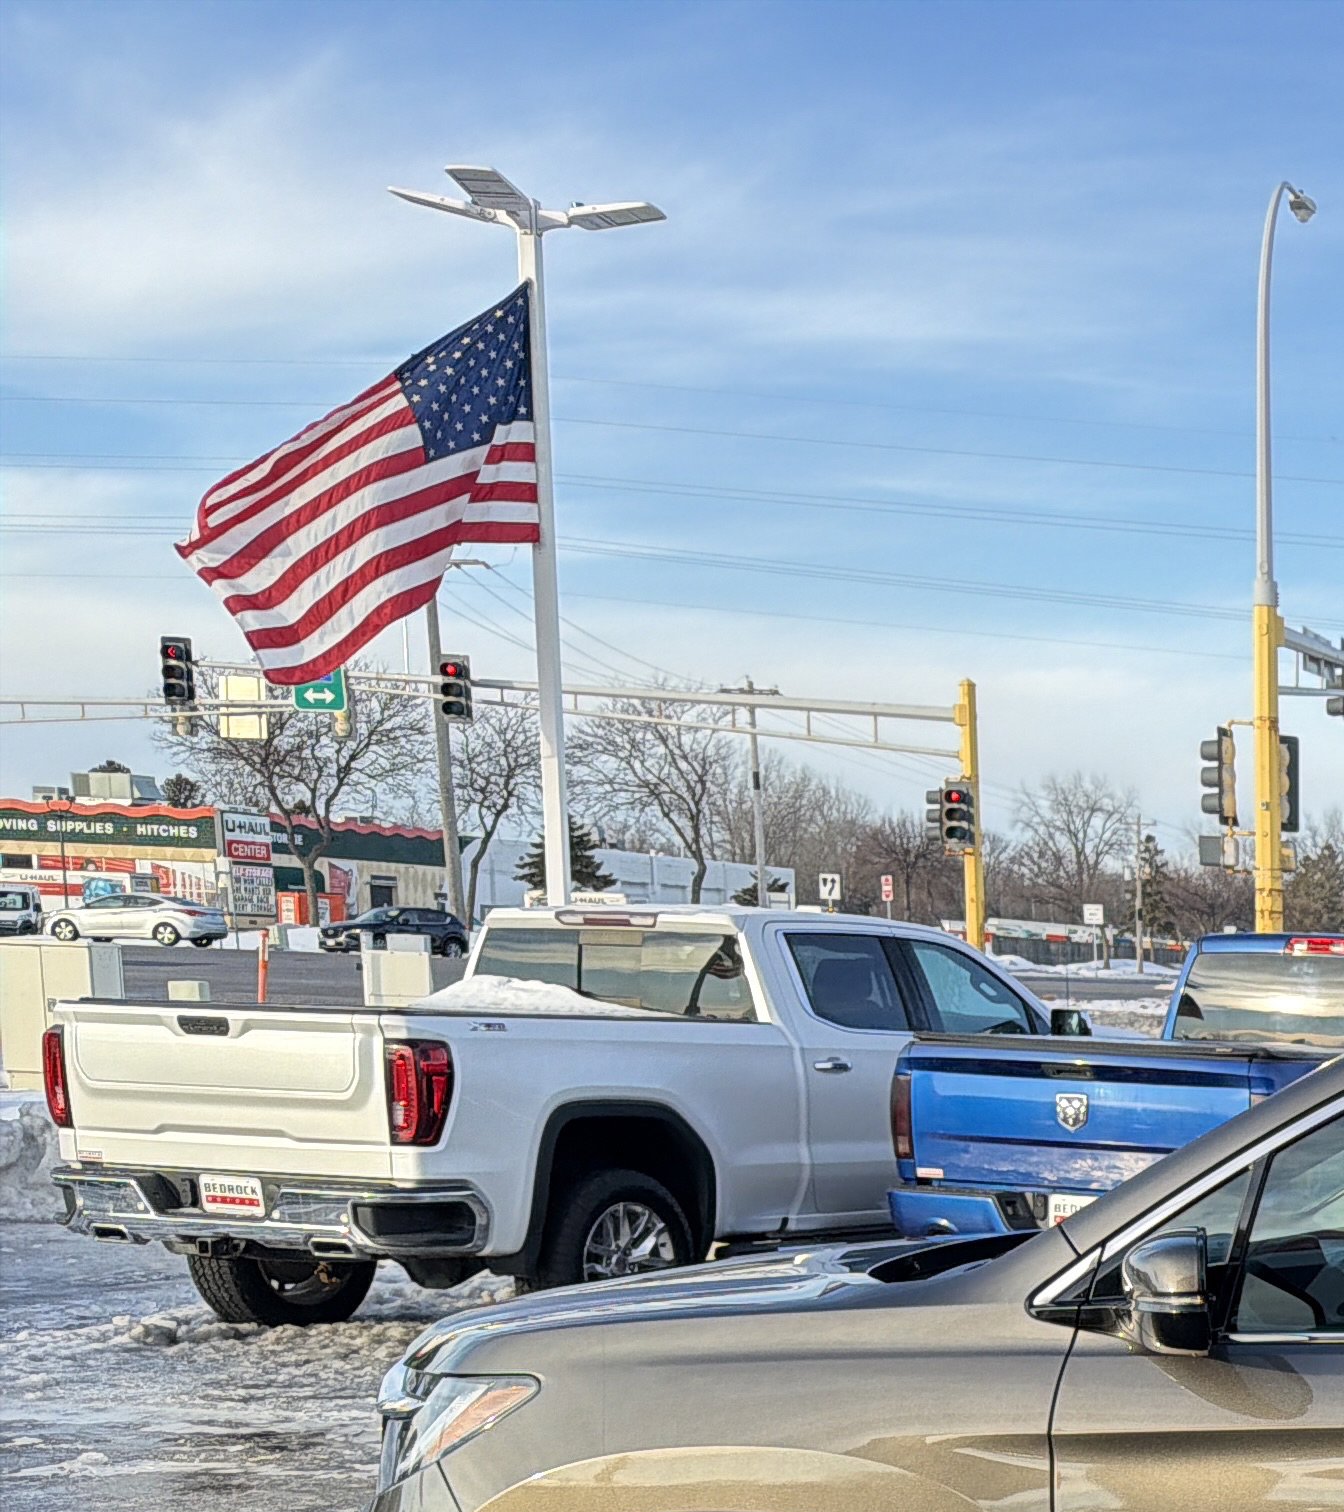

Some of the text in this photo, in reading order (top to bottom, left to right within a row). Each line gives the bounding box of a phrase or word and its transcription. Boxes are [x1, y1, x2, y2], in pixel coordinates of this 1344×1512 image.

[47, 819, 114, 834] SUPPLIES
[136, 824, 198, 838] HITCHES
[231, 843, 267, 858] CENTER
[204, 1183, 258, 1196] BEDROCK
